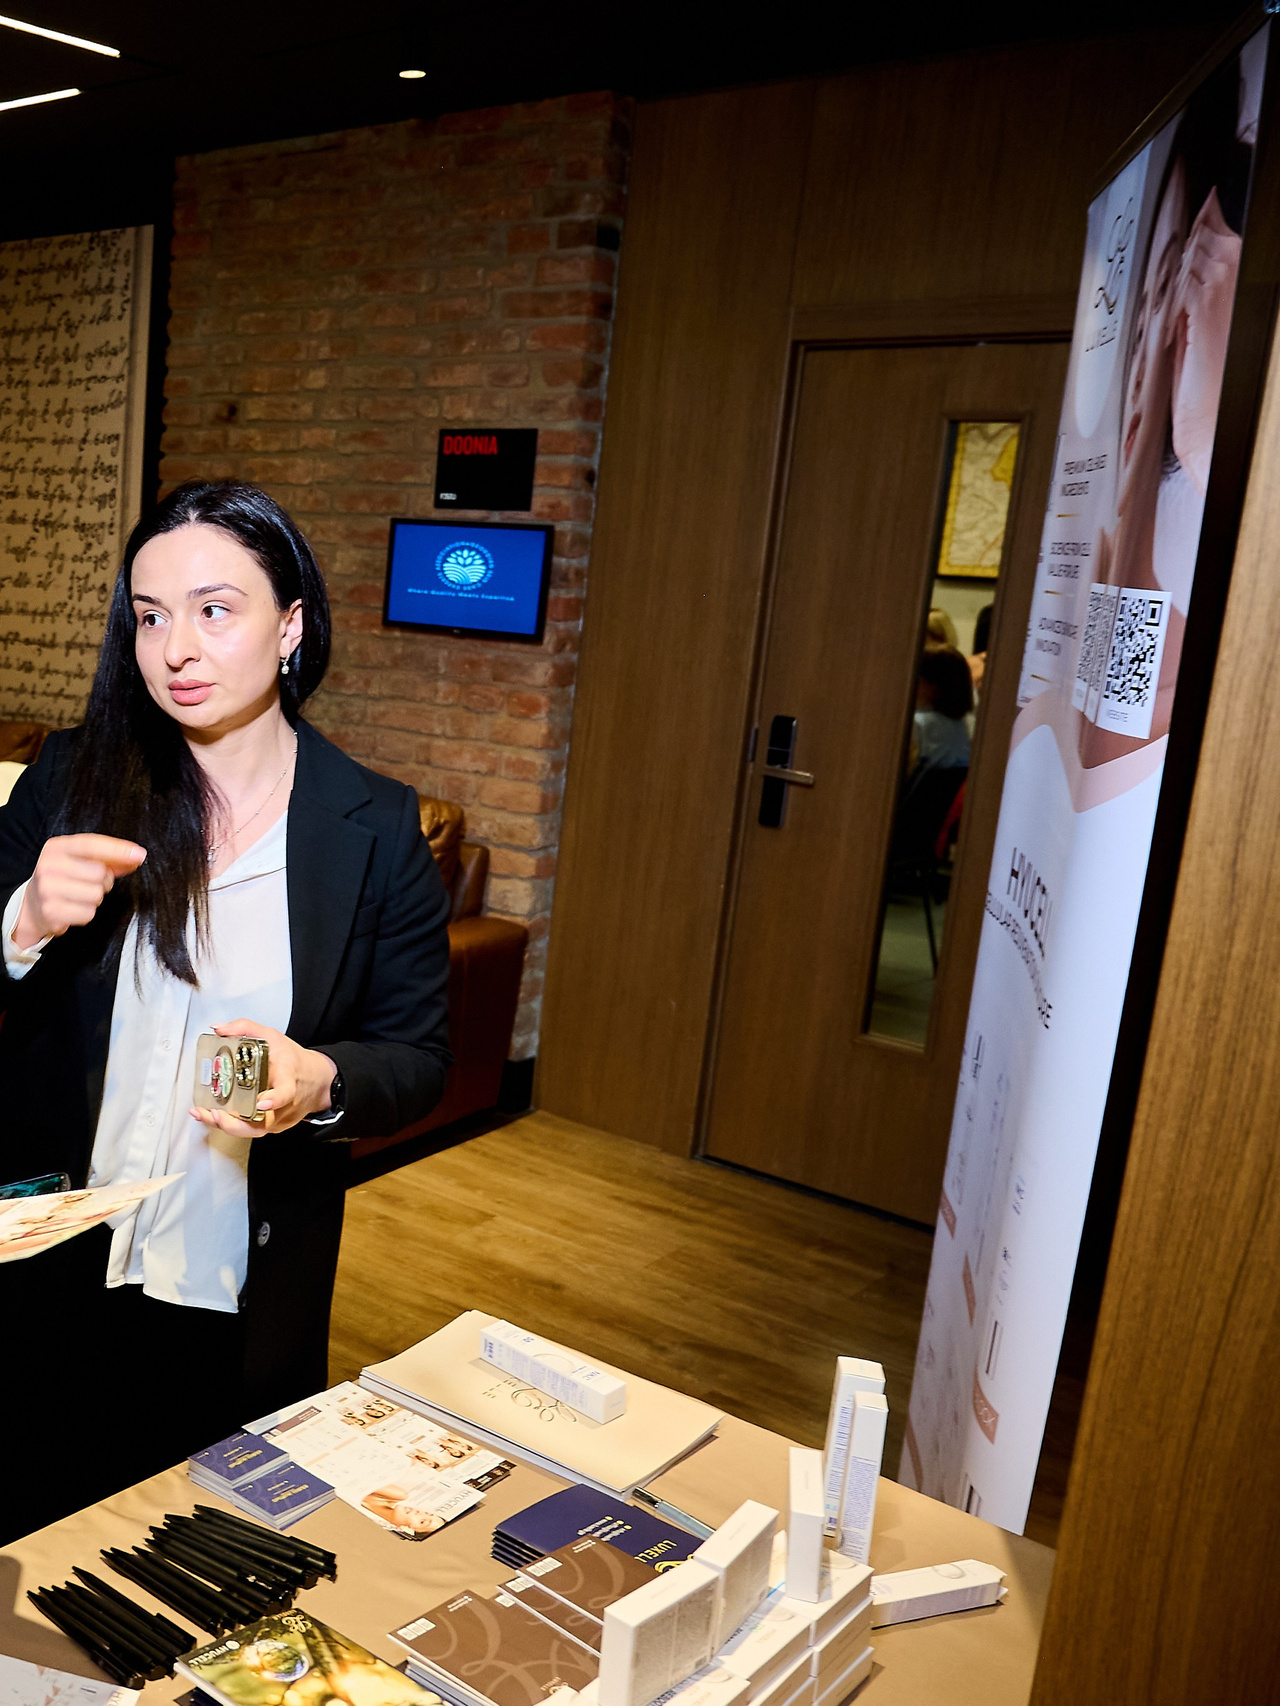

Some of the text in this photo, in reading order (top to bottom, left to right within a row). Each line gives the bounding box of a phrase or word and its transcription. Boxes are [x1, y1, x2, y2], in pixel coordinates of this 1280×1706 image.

[442, 435, 498, 456] DOONIA
[435, 1489, 473, 1513] HYUCELL
[188, 1645, 227, 1666] HYUCELL
